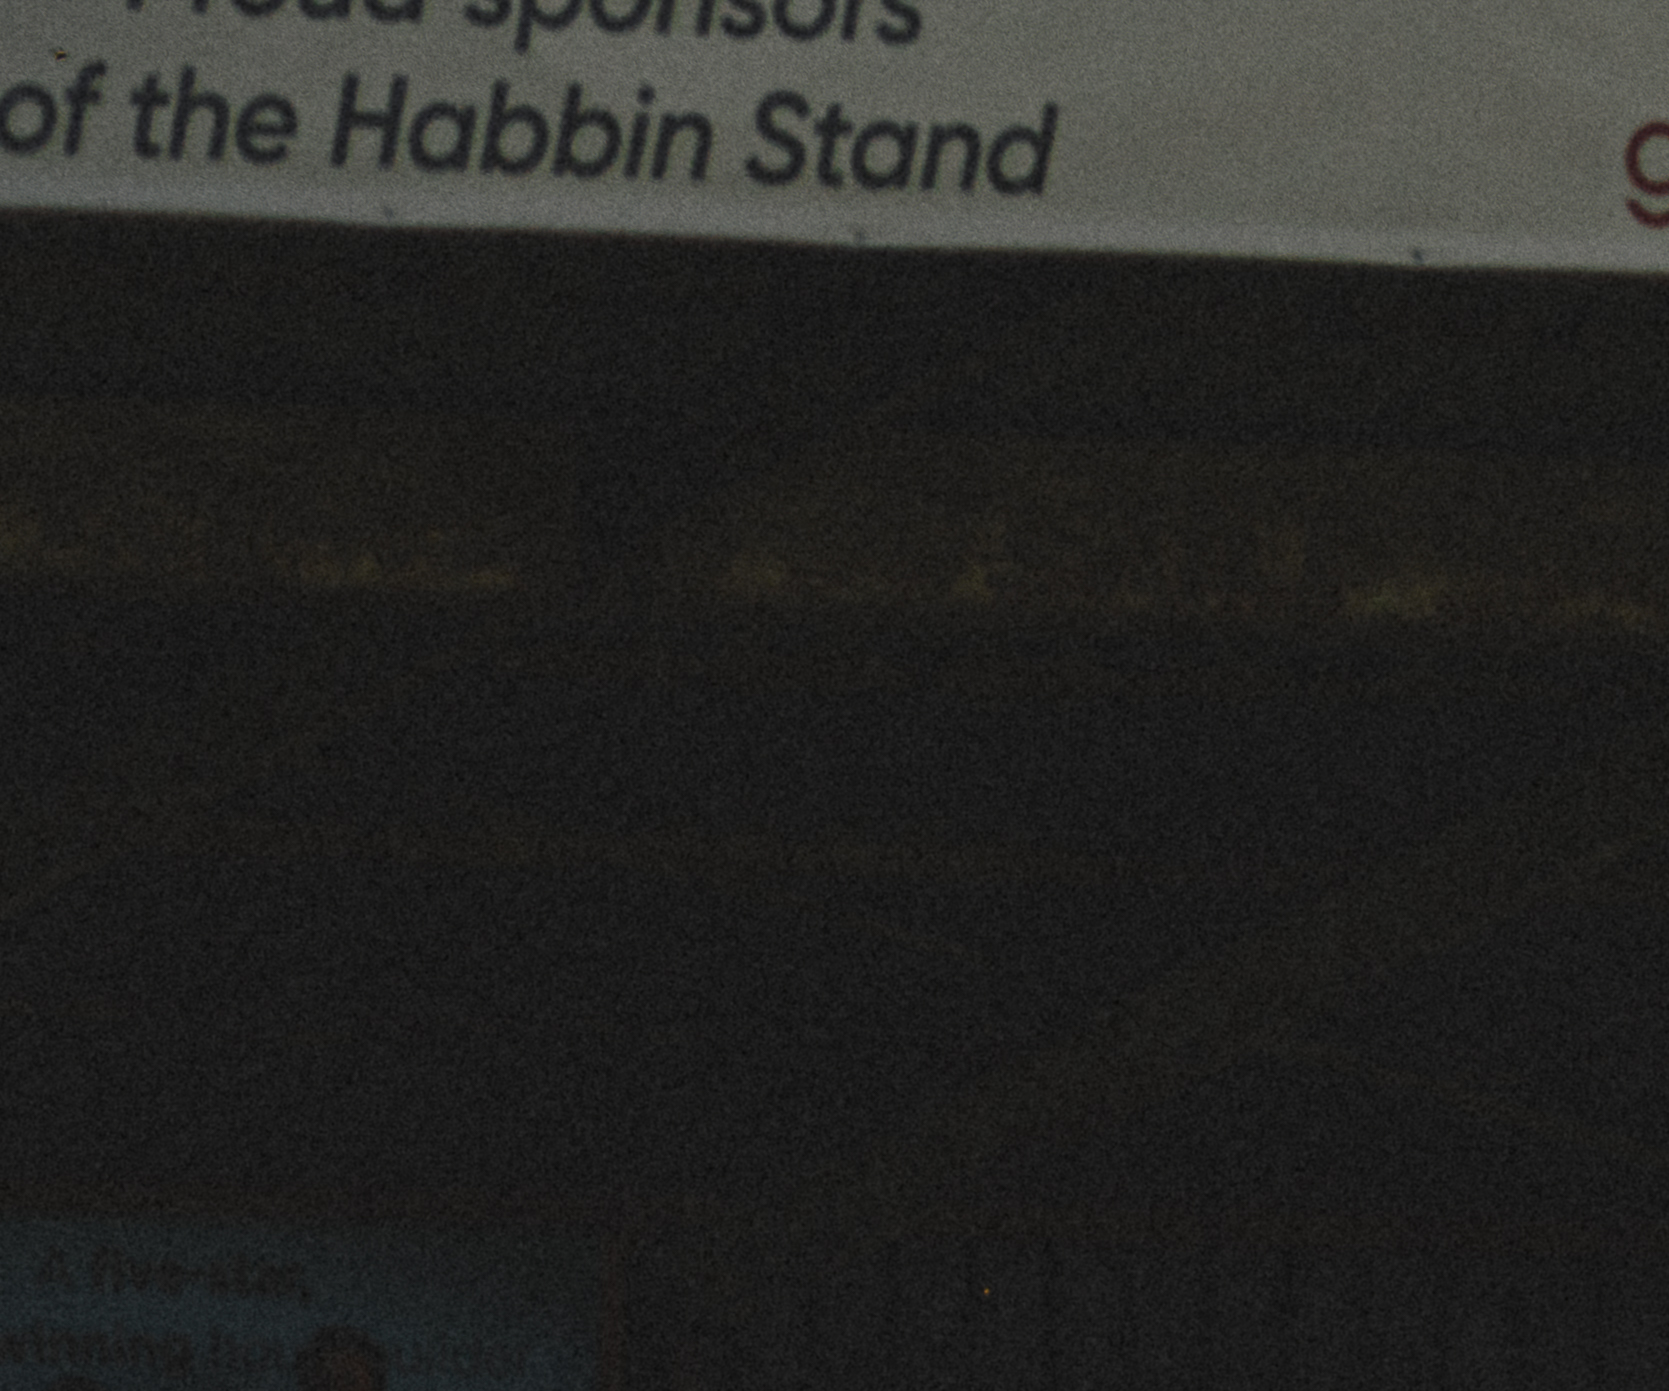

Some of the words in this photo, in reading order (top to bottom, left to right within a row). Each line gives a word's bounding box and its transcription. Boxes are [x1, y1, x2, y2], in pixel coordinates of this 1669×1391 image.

[0, 62, 106, 157] of
[130, 66, 299, 164] the
[330, 73, 713, 182] Habbin
[746, 91, 1060, 195] Stand
